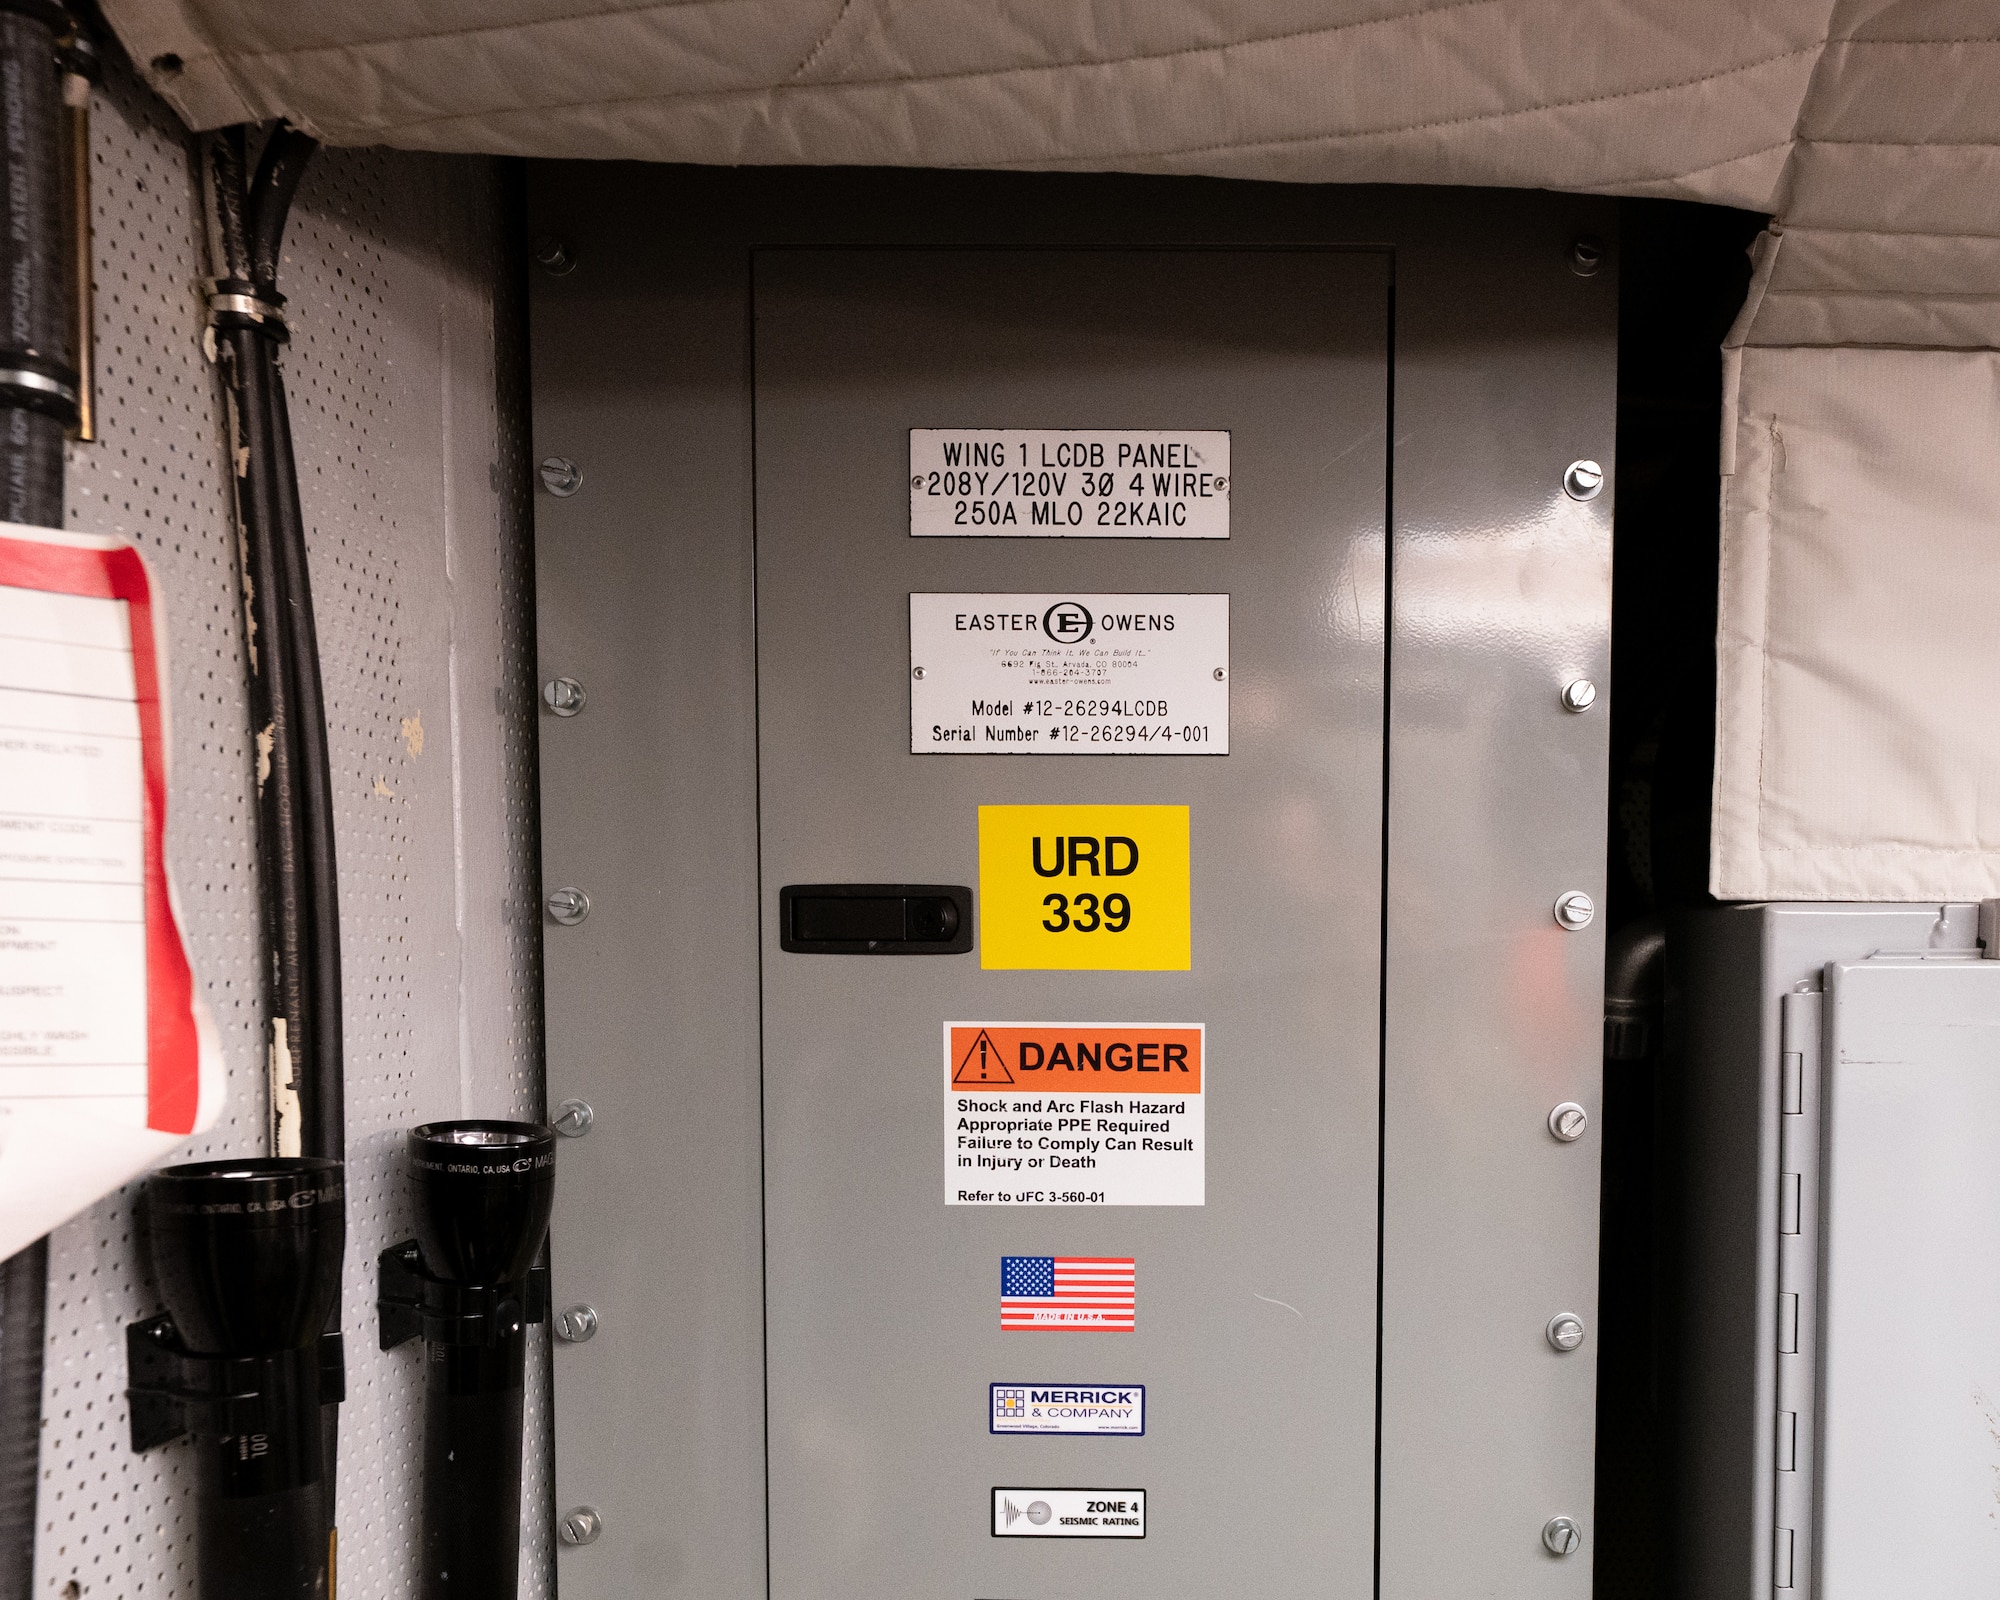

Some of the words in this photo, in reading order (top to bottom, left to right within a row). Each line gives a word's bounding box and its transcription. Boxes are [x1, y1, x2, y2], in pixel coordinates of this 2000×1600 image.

[943, 443, 1004, 467] WING
[1020, 443, 1026, 467] 1
[1042, 443, 1104, 467] LCDB
[1118, 443, 1198, 469] PANEL
[928, 471, 1066, 496] 208Y/120V
[1129, 473, 1144, 496] 4
[1153, 473, 1213, 497] WIRE
[955, 501, 1017, 525] 250A
[1032, 502, 1082, 525] MLO
[1098, 502, 1186, 526] 22KAIC
[956, 615, 1036, 630] EASTER
[1102, 615, 1174, 631] OWENS
[1001, 660, 1025, 668] 6692
[973, 700, 1012, 716] Model
[1023, 700, 1167, 716] #12-26294LCDB
[932, 724, 976, 743] Serial
[986, 726, 1038, 741] Number
[1050, 726, 1207, 741] #12-26294/4-001
[1033, 837, 1138, 877] URD
[1043, 893, 1130, 932] 339
[1020, 1042, 1189, 1072] DANGER
[958, 1099, 1007, 1112] Shock
[1013, 1100, 1041, 1112] and
[1047, 1100, 1074, 1112] Arc
[1081, 1101, 1123, 1113] Flash
[1130, 1101, 1184, 1114] Hazard
[957, 1118, 1052, 1134] Appropriate
[1059, 1119, 1091, 1131] PPE
[1098, 1119, 1169, 1135] Required
[958, 1136, 1012, 1149] Failure
[1017, 1138, 1032, 1149] to
[1038, 1137, 1099, 1153] Comply
[1106, 1138, 1136, 1150] Can
[1143, 1138, 1193, 1151] Result
[495, 1164, 511, 1174] USA
[958, 1155, 971, 1166] in
[978, 1155, 1022, 1170] Injury
[1028, 1157, 1045, 1168] or
[1050, 1156, 1095, 1168] Death
[959, 1191, 994, 1201] Refer
[998, 1192, 1011, 1201] to
[1016, 1192, 1044, 1202] UFC
[1049, 1192, 1104, 1202] 3-560-01
[1033, 1313, 1060, 1321] MADE
[1065, 1313, 1075, 1321] IN
[1032, 1408, 1041, 1417] &
[1048, 1408, 1132, 1417] COMPANY
[250, 1433, 269, 1460] 100
[1087, 1502, 1126, 1512] ZONE
[1130, 1502, 1139, 1513] 4
